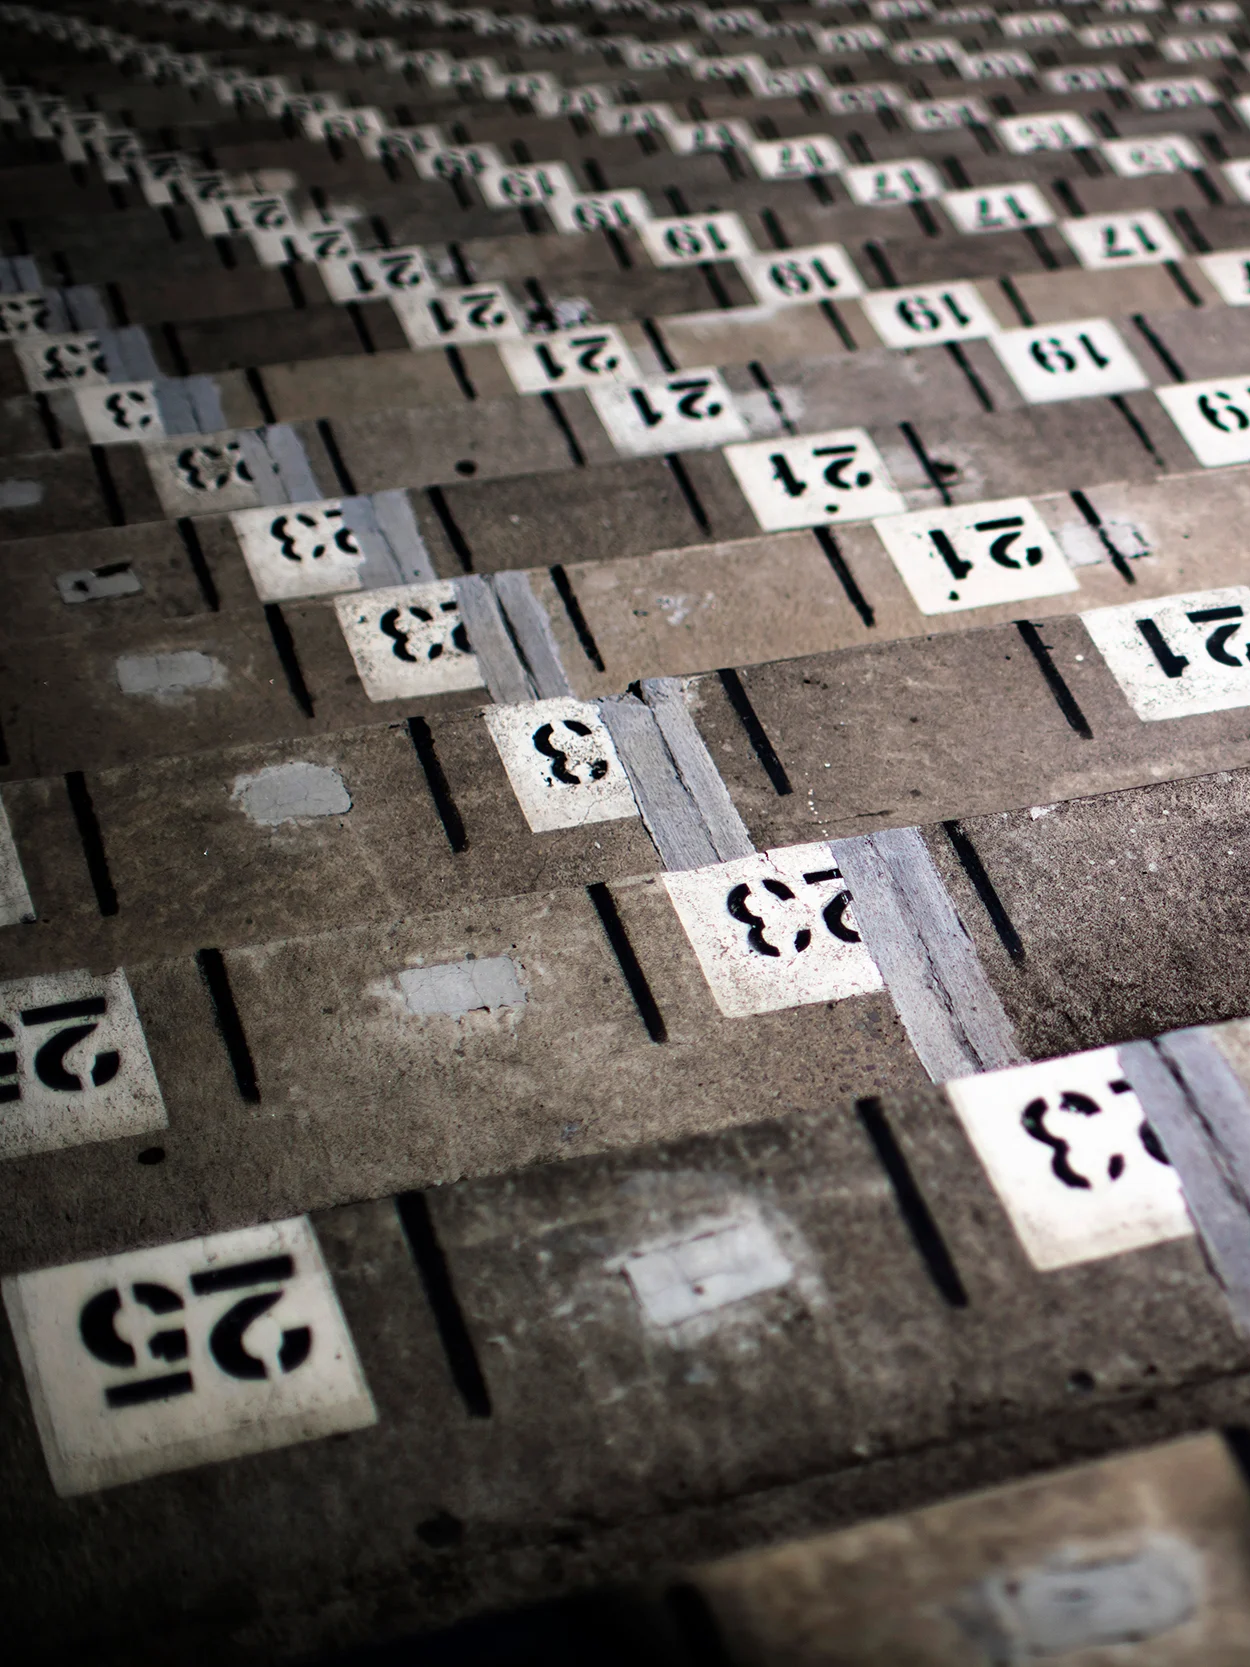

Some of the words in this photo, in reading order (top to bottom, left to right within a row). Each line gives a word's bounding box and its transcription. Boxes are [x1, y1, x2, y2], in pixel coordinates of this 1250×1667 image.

[500, 169, 554, 199] 19
[873, 168, 921, 200] 17
[222, 199, 287, 230] 21
[573, 198, 632, 233] 19
[977, 193, 1028, 228] 17
[281, 229, 350, 263] 21
[664, 222, 728, 259] 19
[1104, 223, 1158, 258] 17
[350, 255, 421, 293] 21
[768, 258, 838, 296] 19
[429, 294, 506, 335] 21
[896, 293, 971, 332] 19
[535, 335, 619, 380] 21
[1030, 333, 1109, 374] 19
[630, 378, 723, 428] 21
[770, 444, 873, 498] 21
[929, 515, 1044, 580] 21
[0, 995, 120, 1101] 2
[79, 1254, 312, 1409] 25
